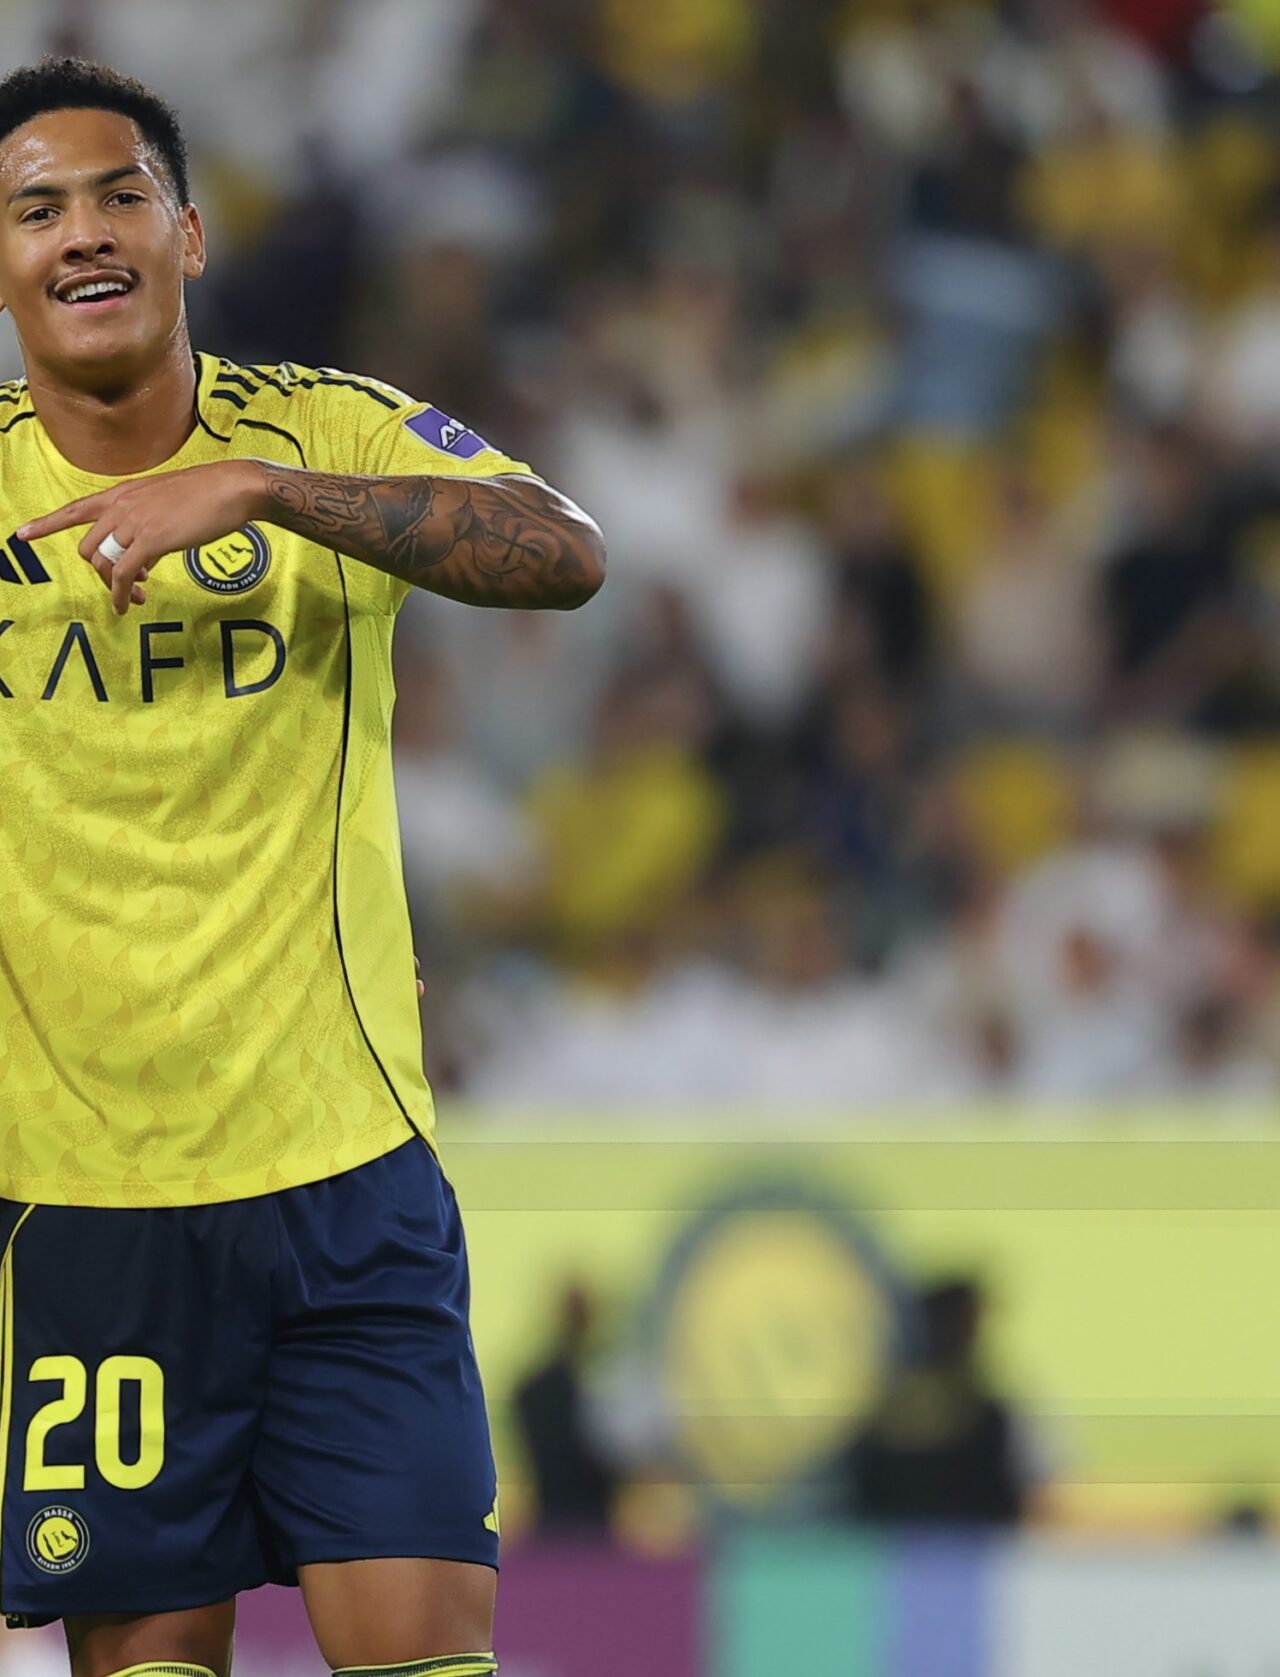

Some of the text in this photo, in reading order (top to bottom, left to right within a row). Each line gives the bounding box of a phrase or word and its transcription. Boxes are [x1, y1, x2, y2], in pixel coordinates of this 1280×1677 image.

[206, 578, 239, 590] RIYADH
[23, 1355, 165, 1492] 20
[43, 1508, 73, 1520] NASSR
